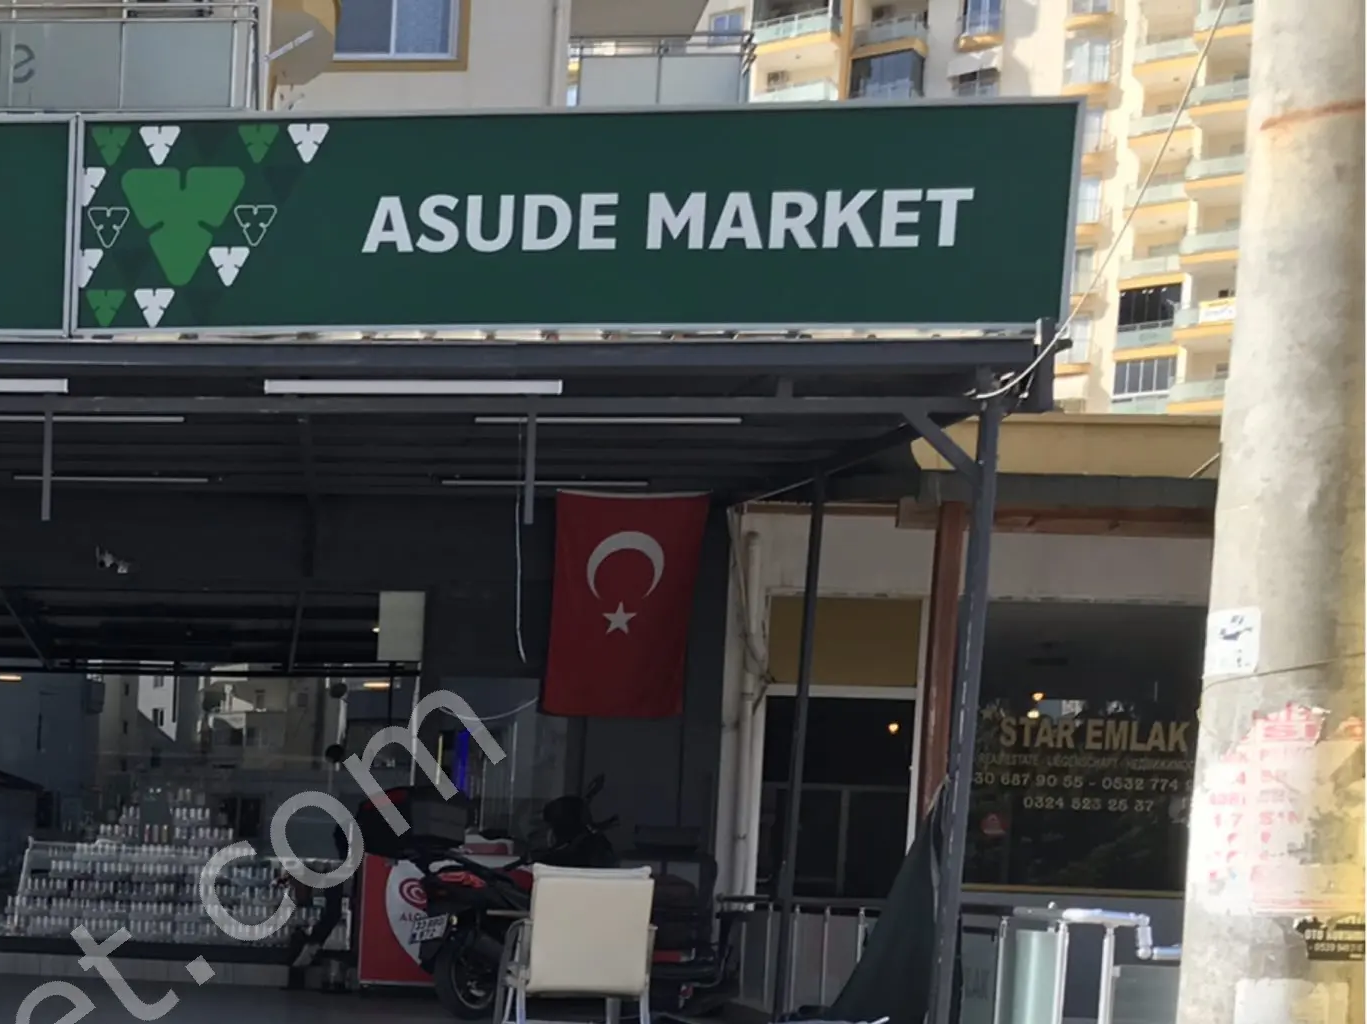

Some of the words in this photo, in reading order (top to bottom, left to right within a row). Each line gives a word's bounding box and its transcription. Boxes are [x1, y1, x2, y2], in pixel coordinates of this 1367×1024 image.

[362, 192, 619, 254] ASUDE
[646, 187, 975, 250] MARKET
[999, 716, 1075, 749] STAR
[1085, 718, 1190, 752] EMLAK
[1000, 772, 1030, 787] 687
[1035, 773, 1058, 788] 90
[1101, 776, 1145, 791] 0532
[1151, 778, 1179, 792] 774
[1023, 796, 1064, 810] 0324
